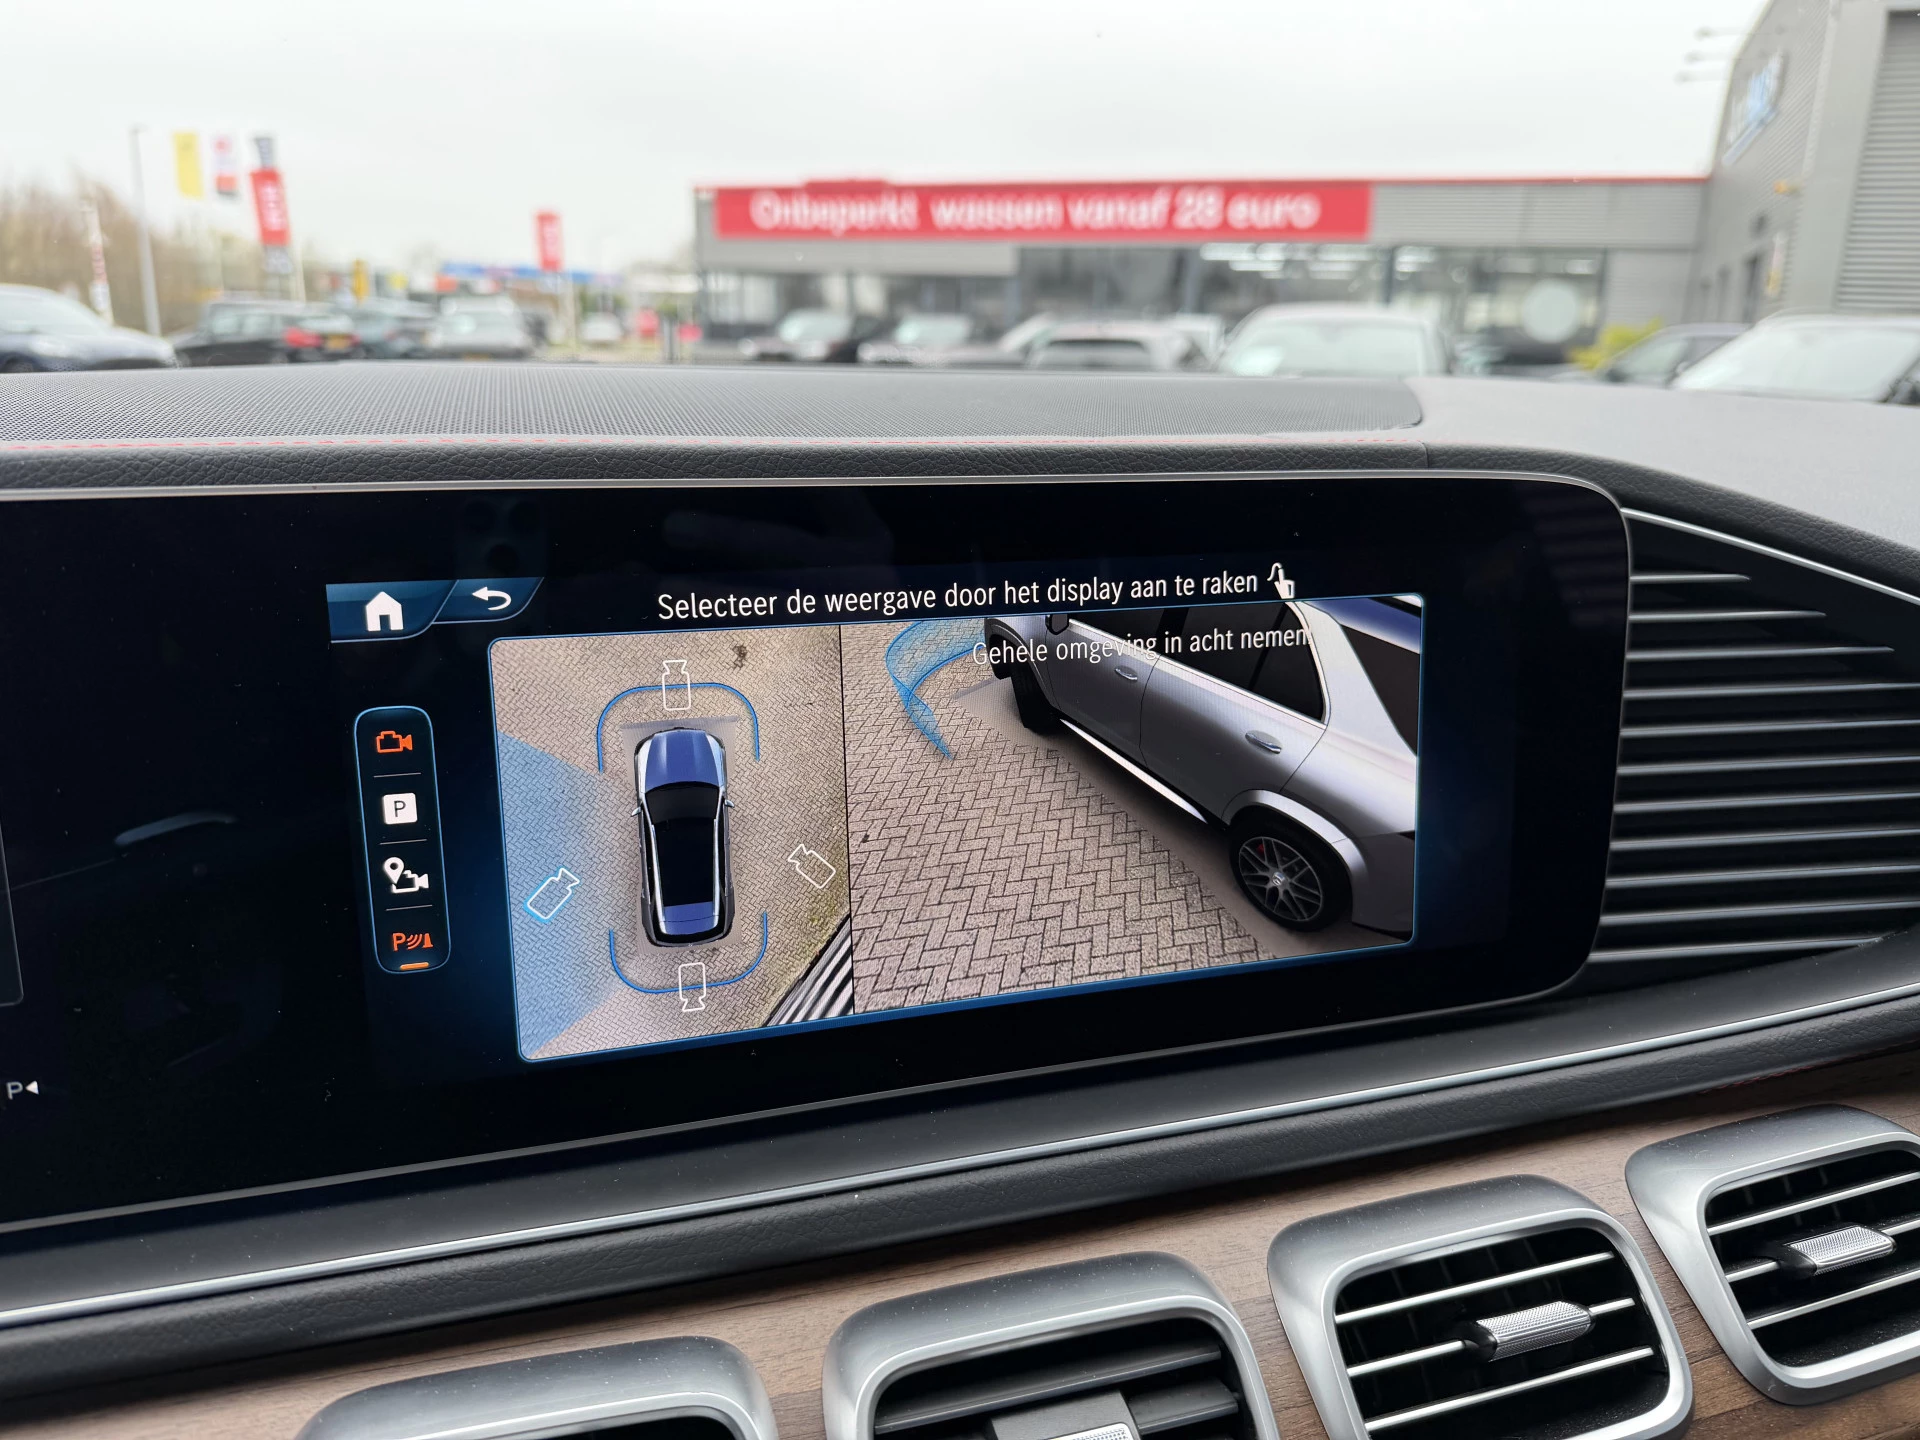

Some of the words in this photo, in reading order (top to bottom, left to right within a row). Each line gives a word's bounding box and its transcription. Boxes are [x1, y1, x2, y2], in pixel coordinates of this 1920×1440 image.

[930, 195, 1064, 231] wassen
[1066, 187, 1172, 231] vanaf
[1173, 186, 1225, 230] 28
[1226, 192, 1321, 230] euro
[658, 592, 777, 620] Selecteer
[786, 589, 816, 614] de
[824, 589, 937, 616] weergave
[945, 582, 997, 607] door
[1004, 580, 1040, 604] het
[1047, 577, 1124, 606] display
[1130, 579, 1168, 599] aan
[1174, 575, 1196, 596] te
[1202, 571, 1258, 595] raken
[973, 639, 1047, 665] Gehele
[1055, 634, 1159, 661] omgeving
[1164, 631, 1183, 654] in
[1189, 628, 1234, 652] acht
[392, 800, 407, 818] P
[6, 1081, 24, 1100] P
